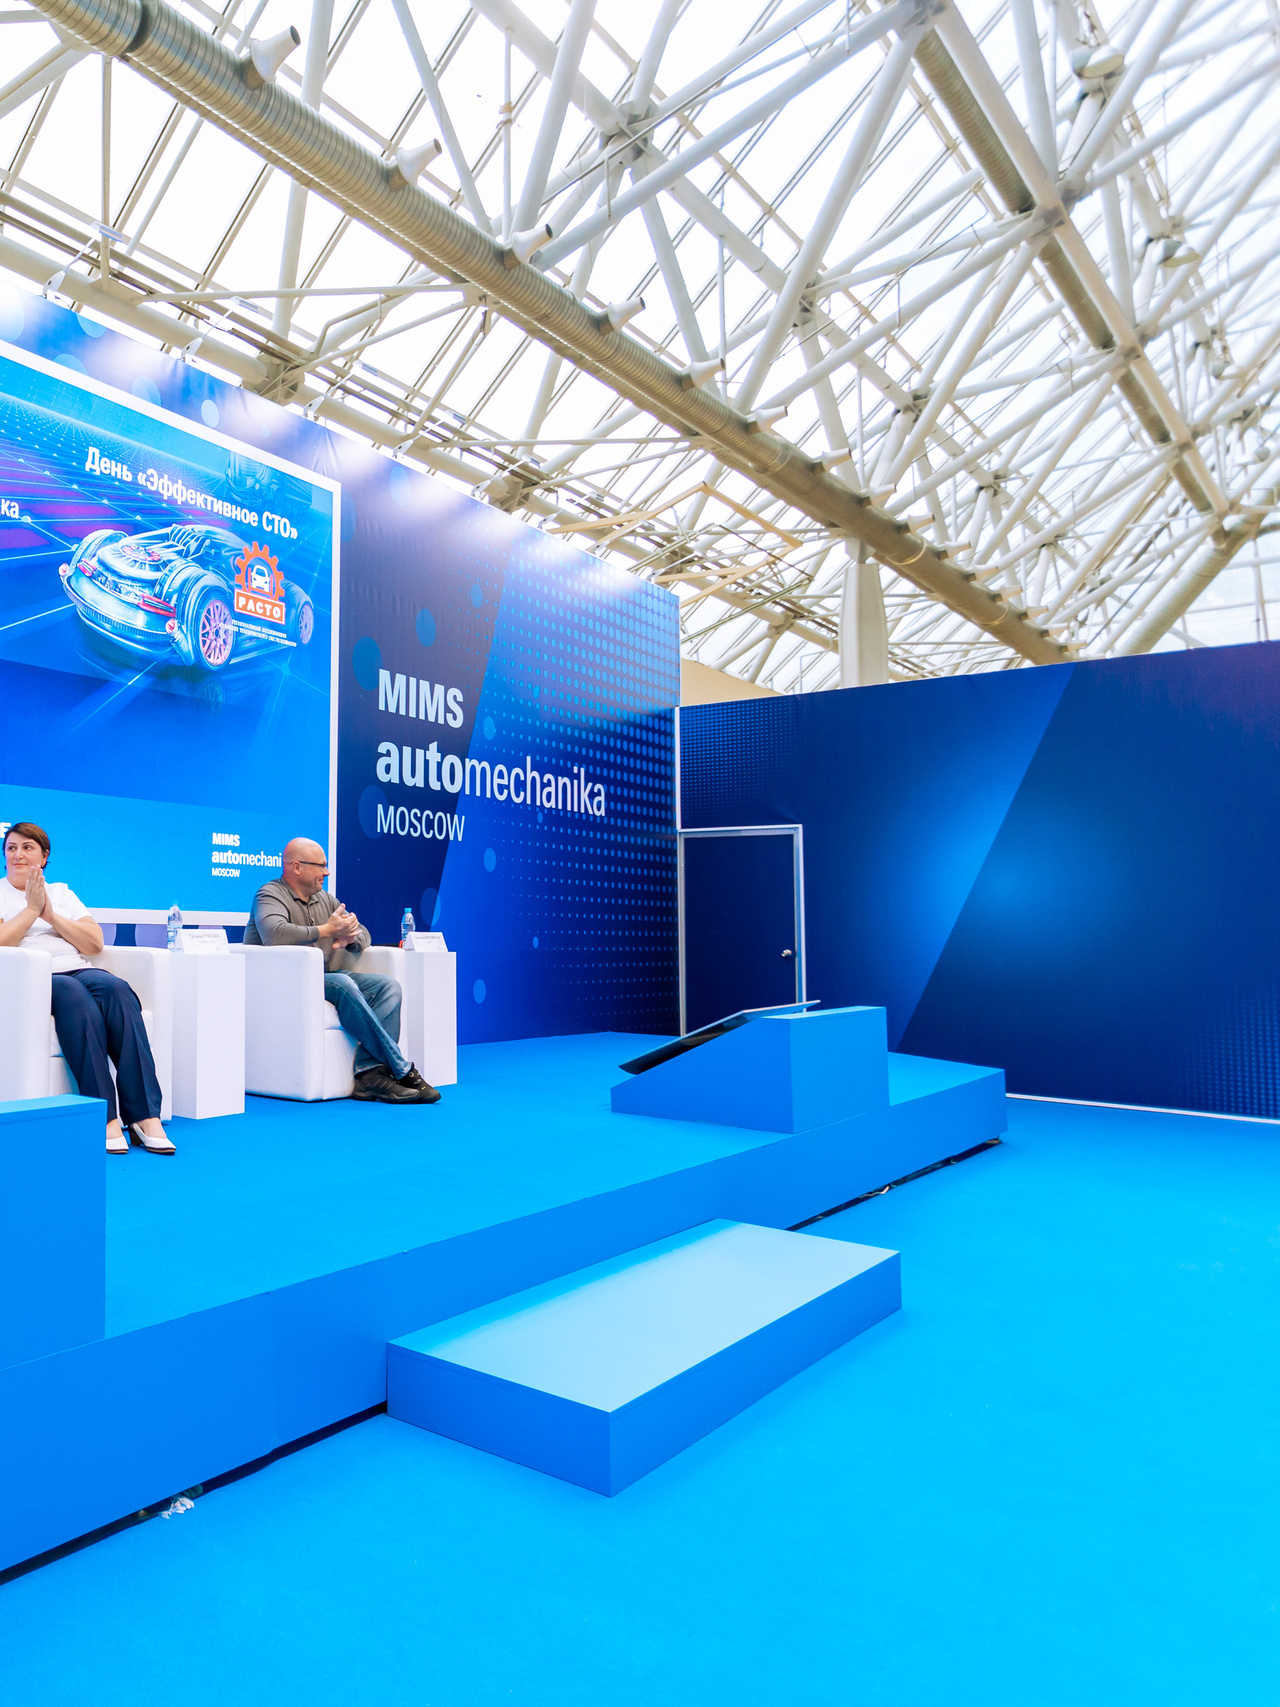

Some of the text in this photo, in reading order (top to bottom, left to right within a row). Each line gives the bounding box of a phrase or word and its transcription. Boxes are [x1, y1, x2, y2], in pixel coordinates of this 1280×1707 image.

[85, 446, 298, 540] День «Эффективное СТО»
[238, 596, 281, 619] РАСТО
[378, 668, 464, 729] MIMS
[376, 741, 606, 817] automechanika
[377, 804, 465, 842] MOSCOW
[212, 832, 240, 847] MIMS
[211, 849, 282, 867] automechani
[211, 867, 240, 878] MOSCOW
